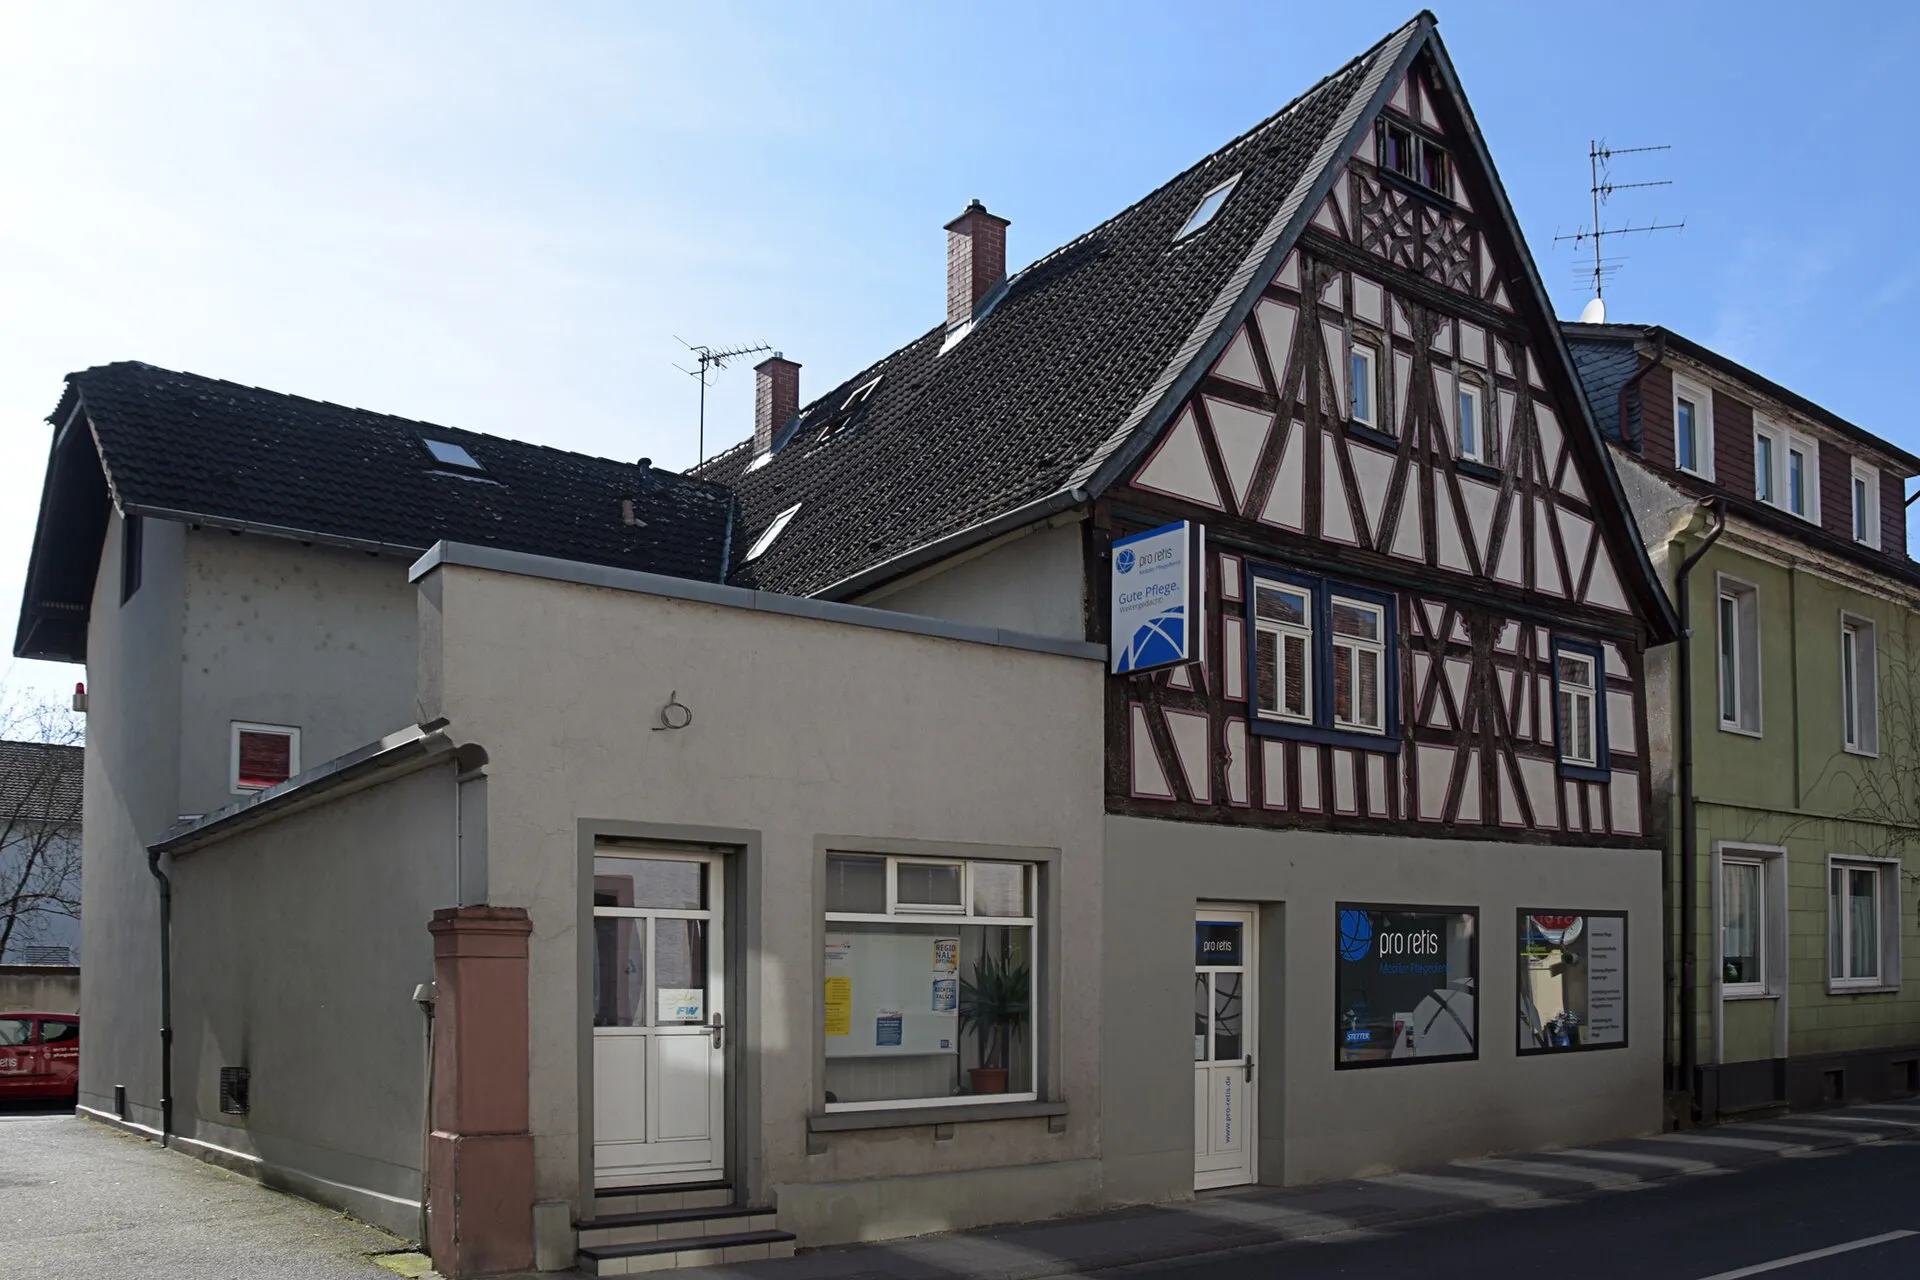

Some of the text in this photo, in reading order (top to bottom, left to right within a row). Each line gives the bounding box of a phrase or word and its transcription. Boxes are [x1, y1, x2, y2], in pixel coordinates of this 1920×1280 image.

[1139, 548, 1172, 567] pro retis
[1118, 582, 1180, 605] Gute Pflege.
[1203, 940, 1232, 952] pro retis
[1380, 929, 1438, 958] pro retis
[676, 1006, 699, 1015] FW
